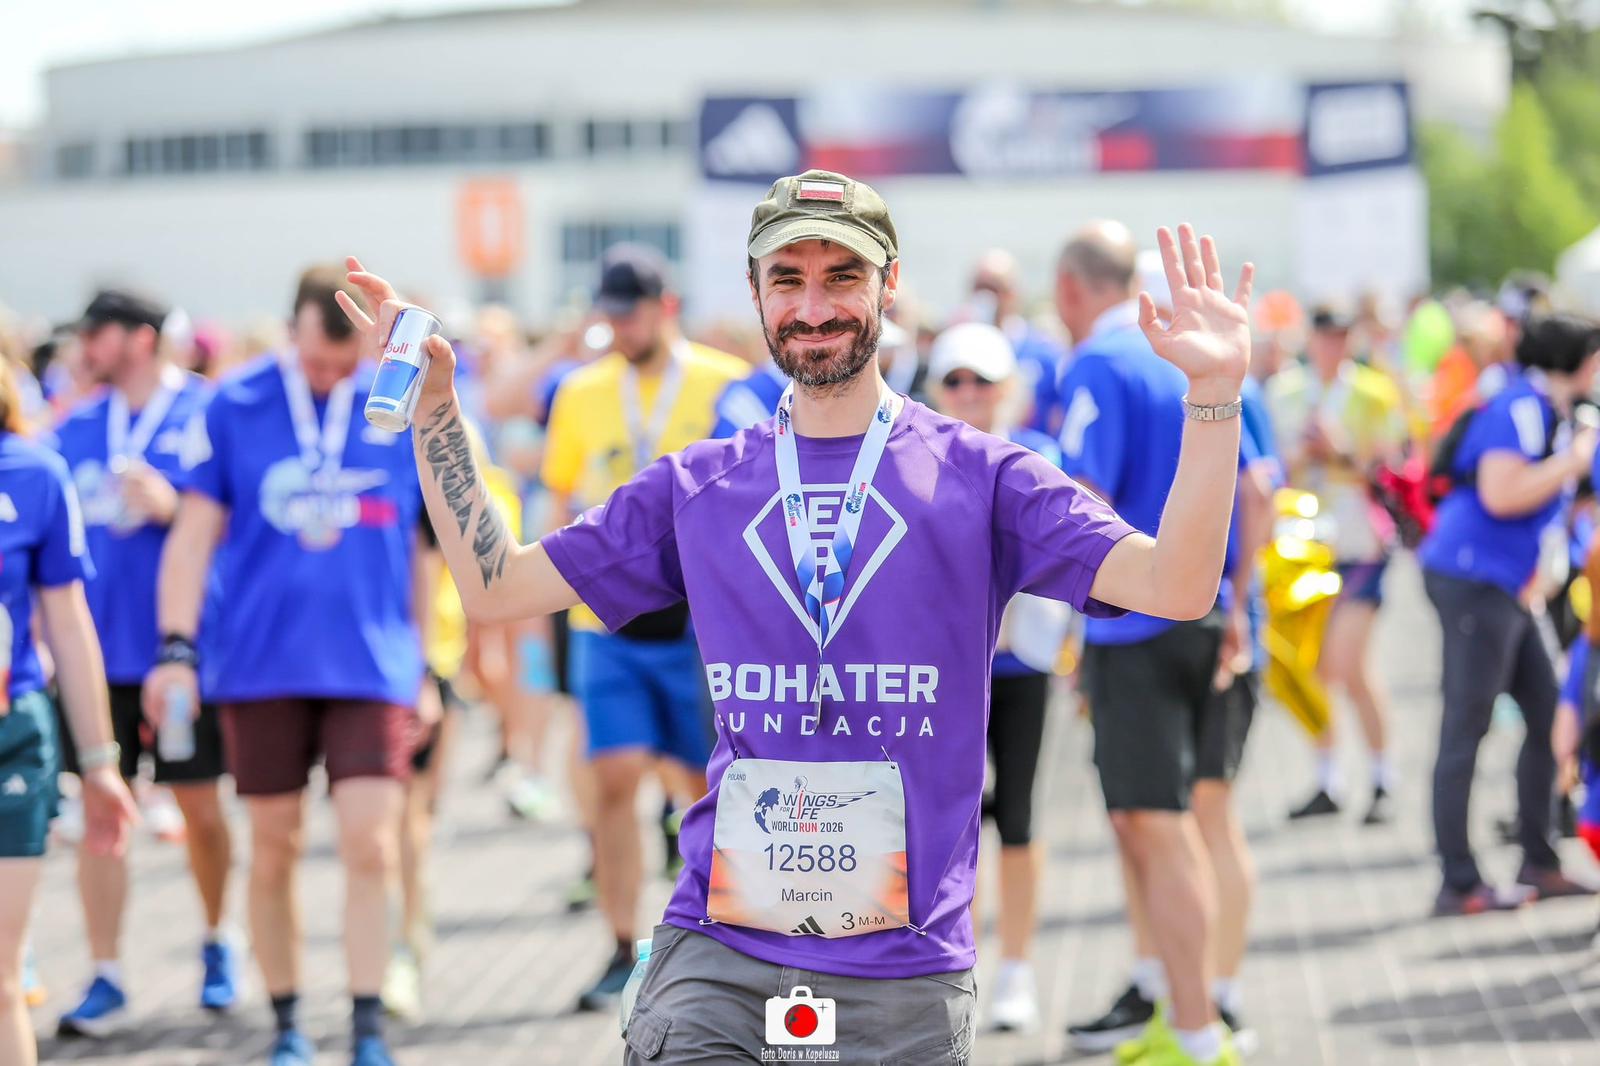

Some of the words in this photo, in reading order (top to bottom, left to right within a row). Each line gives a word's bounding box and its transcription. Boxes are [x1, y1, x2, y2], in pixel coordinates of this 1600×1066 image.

[386, 342, 408, 354] Bull
[706, 663, 939, 703] BOHATER
[717, 711, 934, 737] UNDACJA
[727, 773, 746, 781] POLAND
[820, 822, 844, 833] 2026
[764, 843, 857, 872] 12588
[781, 888, 833, 902] Marcin
[841, 912, 855, 930] 3
[858, 916, 885, 926] M-M
